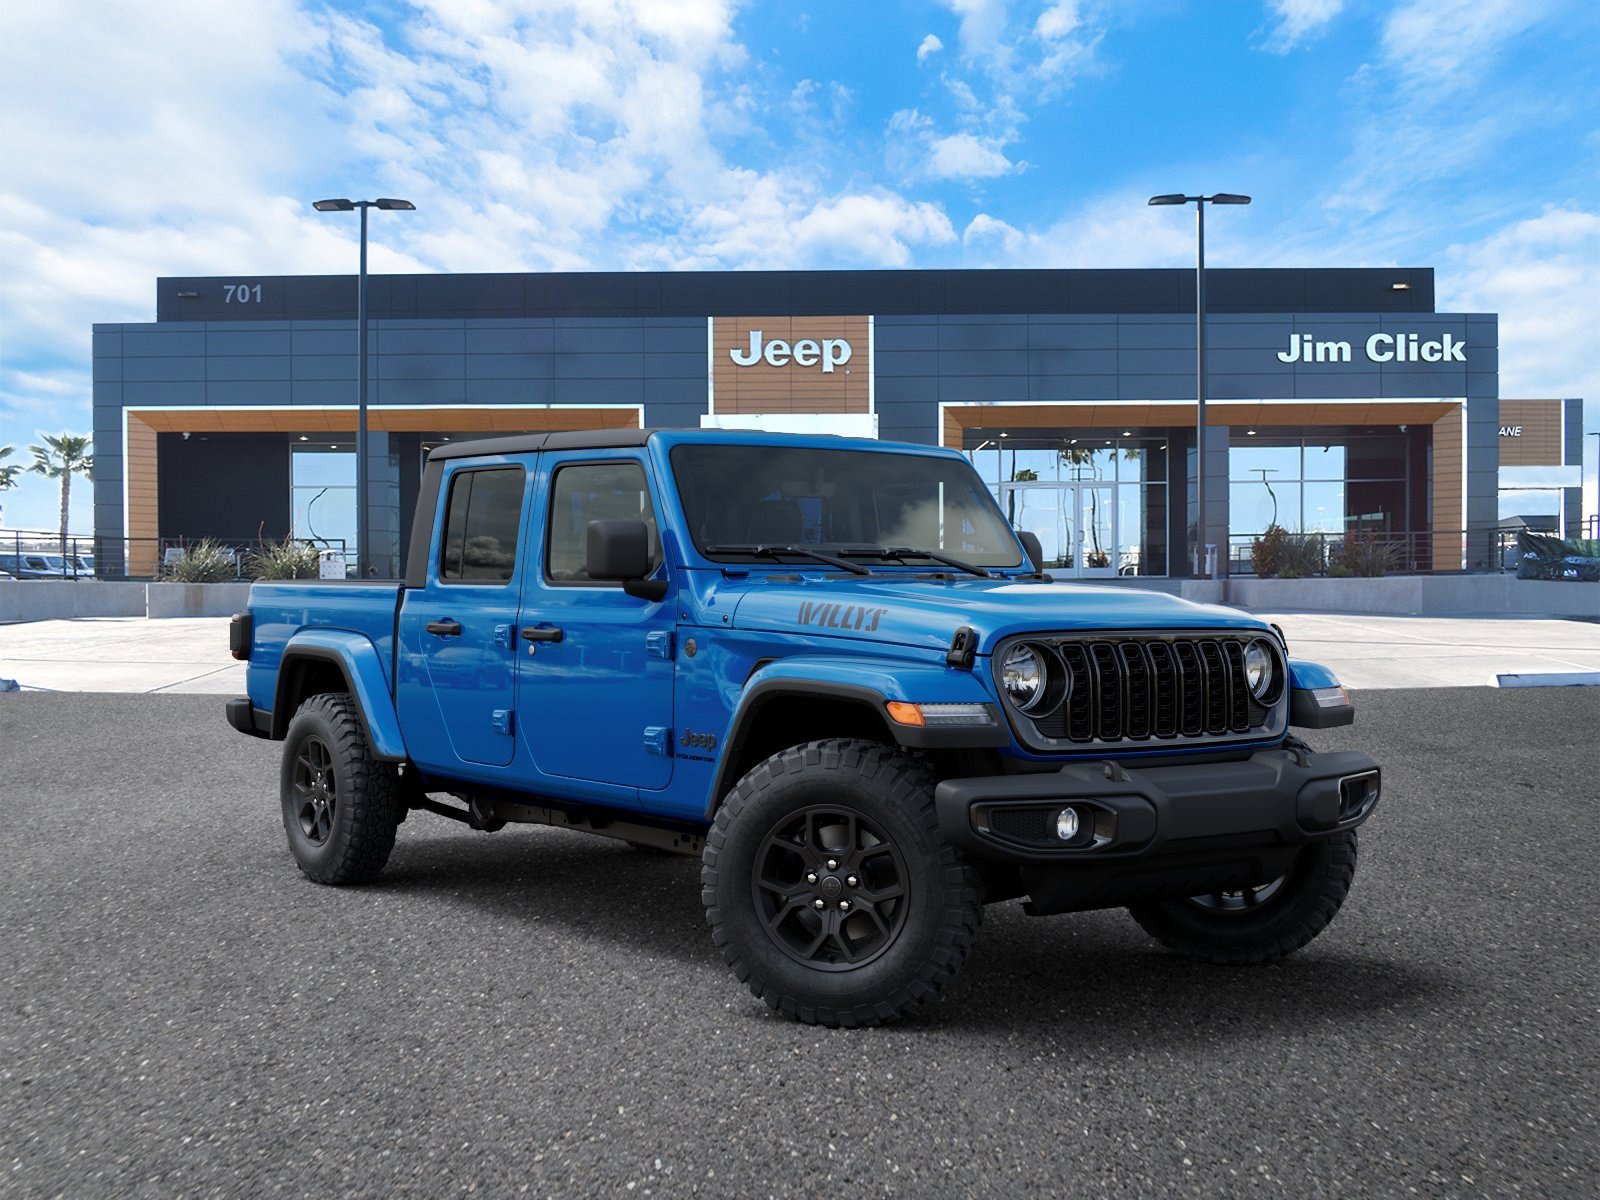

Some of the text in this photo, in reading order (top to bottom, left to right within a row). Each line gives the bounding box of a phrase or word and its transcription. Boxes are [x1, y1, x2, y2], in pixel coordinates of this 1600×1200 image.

[223, 284, 262, 304] 701
[729, 330, 852, 374] Jeep
[1277, 333, 1467, 363] Jim Click
[798, 601, 882, 632] WILLYS
[680, 727, 716, 752] Jeep
